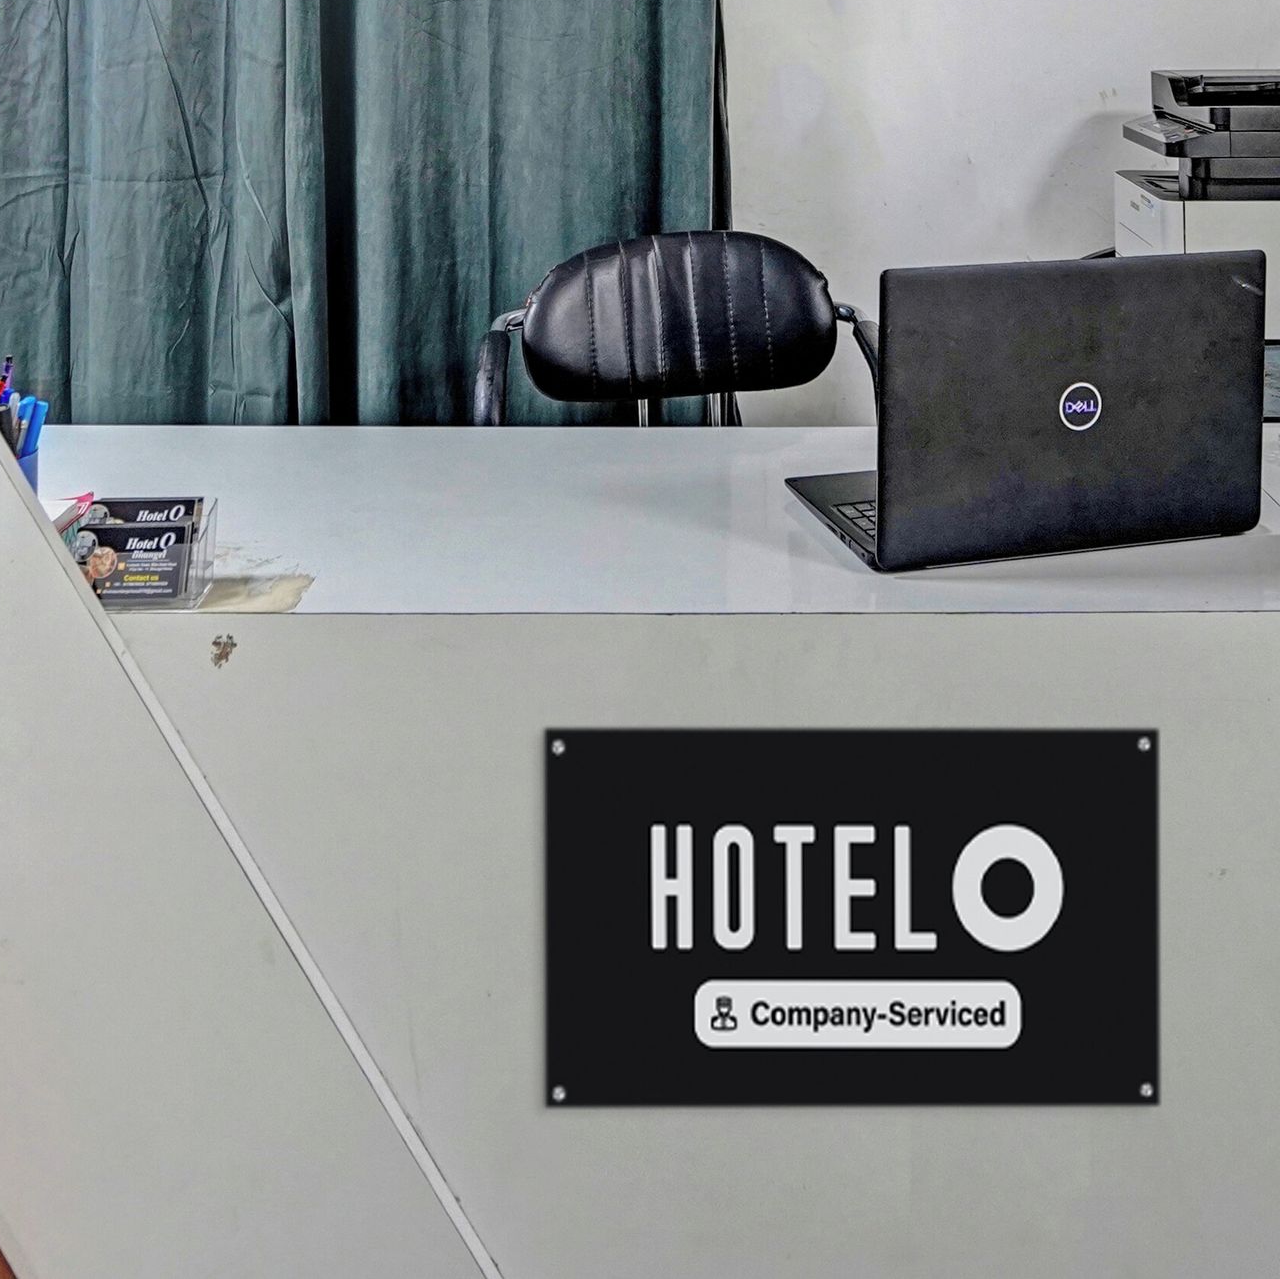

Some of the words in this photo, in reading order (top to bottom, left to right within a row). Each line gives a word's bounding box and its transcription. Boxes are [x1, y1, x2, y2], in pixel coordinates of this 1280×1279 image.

[1065, 400, 1097, 414] DELL
[136, 510, 169, 522] Hotel
[169, 504, 186, 522] O
[125, 537, 159, 550] Hotel
[159, 532, 176, 550] O
[123, 574, 150, 582] Contact
[650, 823, 938, 951] HOTEL
[951, 823, 1065, 953] O
[750, 1000, 1007, 1033] Company-Serviced
